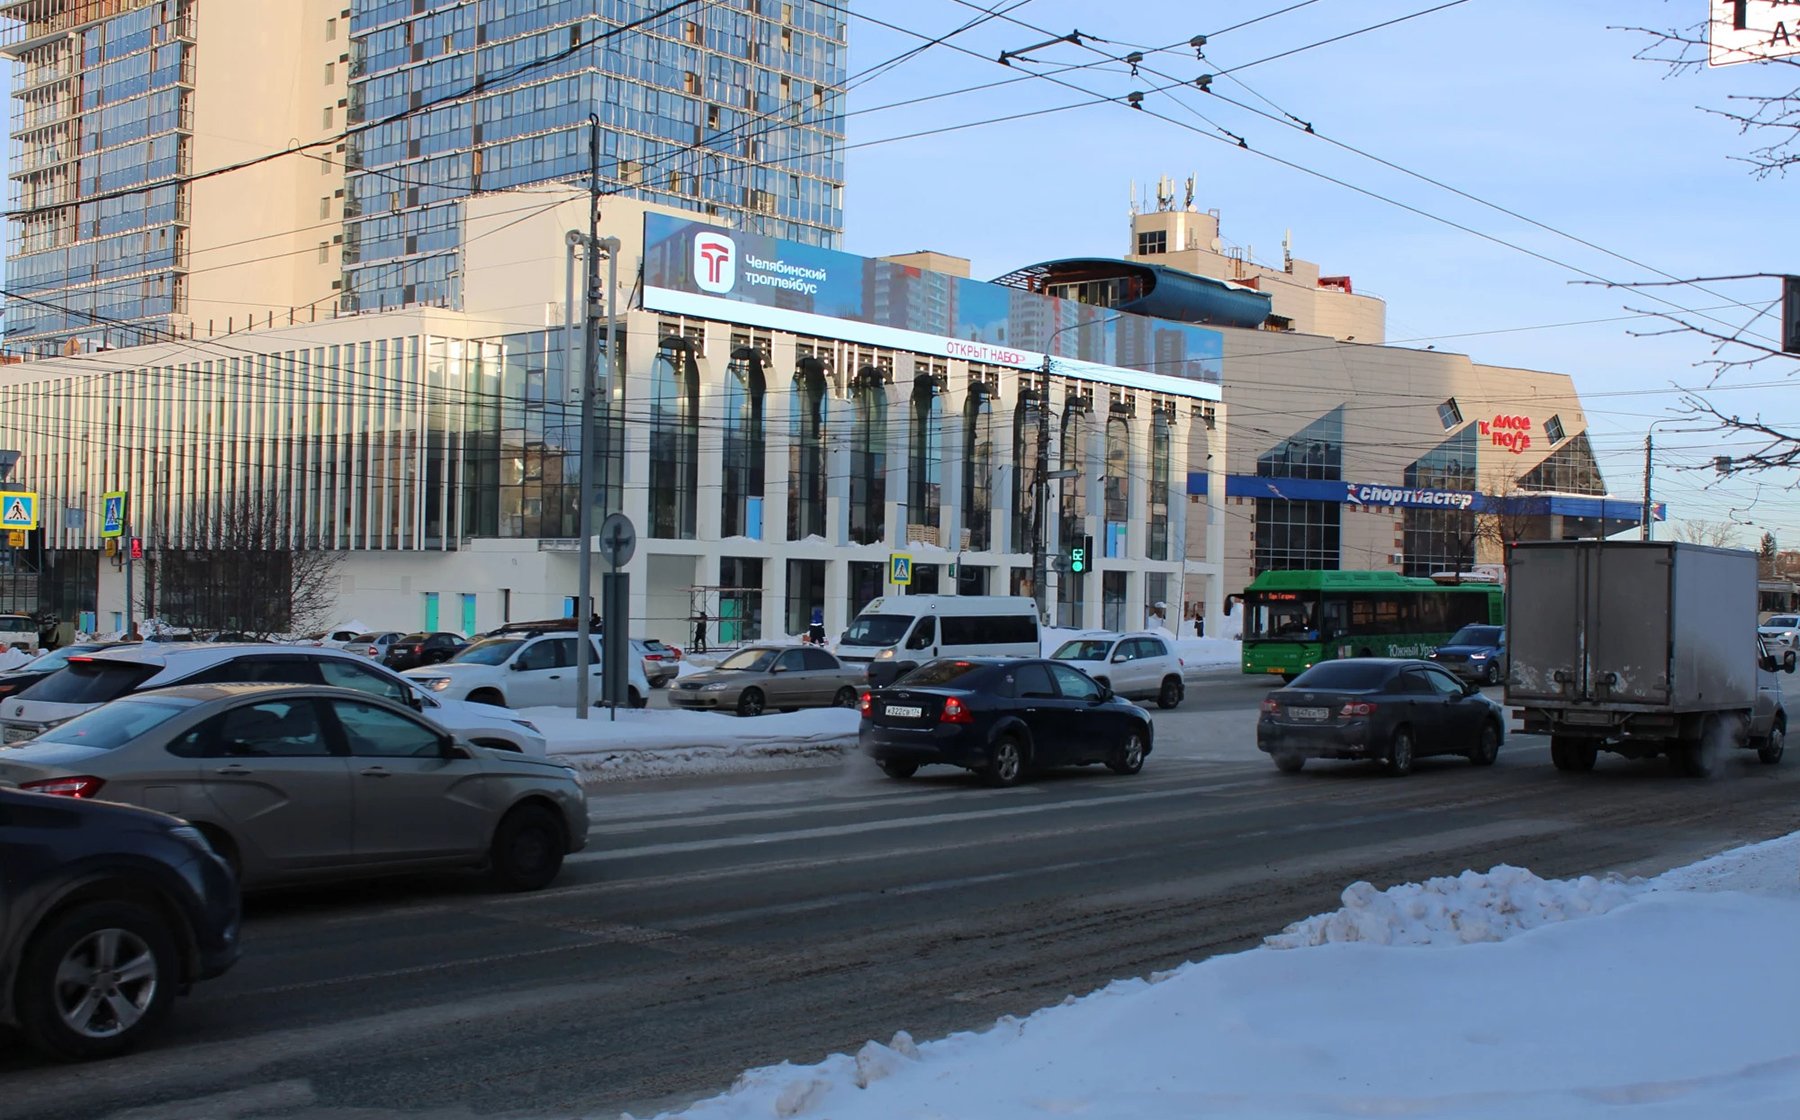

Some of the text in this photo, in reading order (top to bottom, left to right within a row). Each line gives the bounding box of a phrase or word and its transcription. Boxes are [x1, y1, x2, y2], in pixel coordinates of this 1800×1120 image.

[745, 253, 827, 282] Челябинский
[745, 271, 818, 296] троллейбус
[946, 341, 988, 359] ОТКРЫТ
[990, 349, 1026, 364] НАБОР
[1388, 643, 1419, 658] Южный
